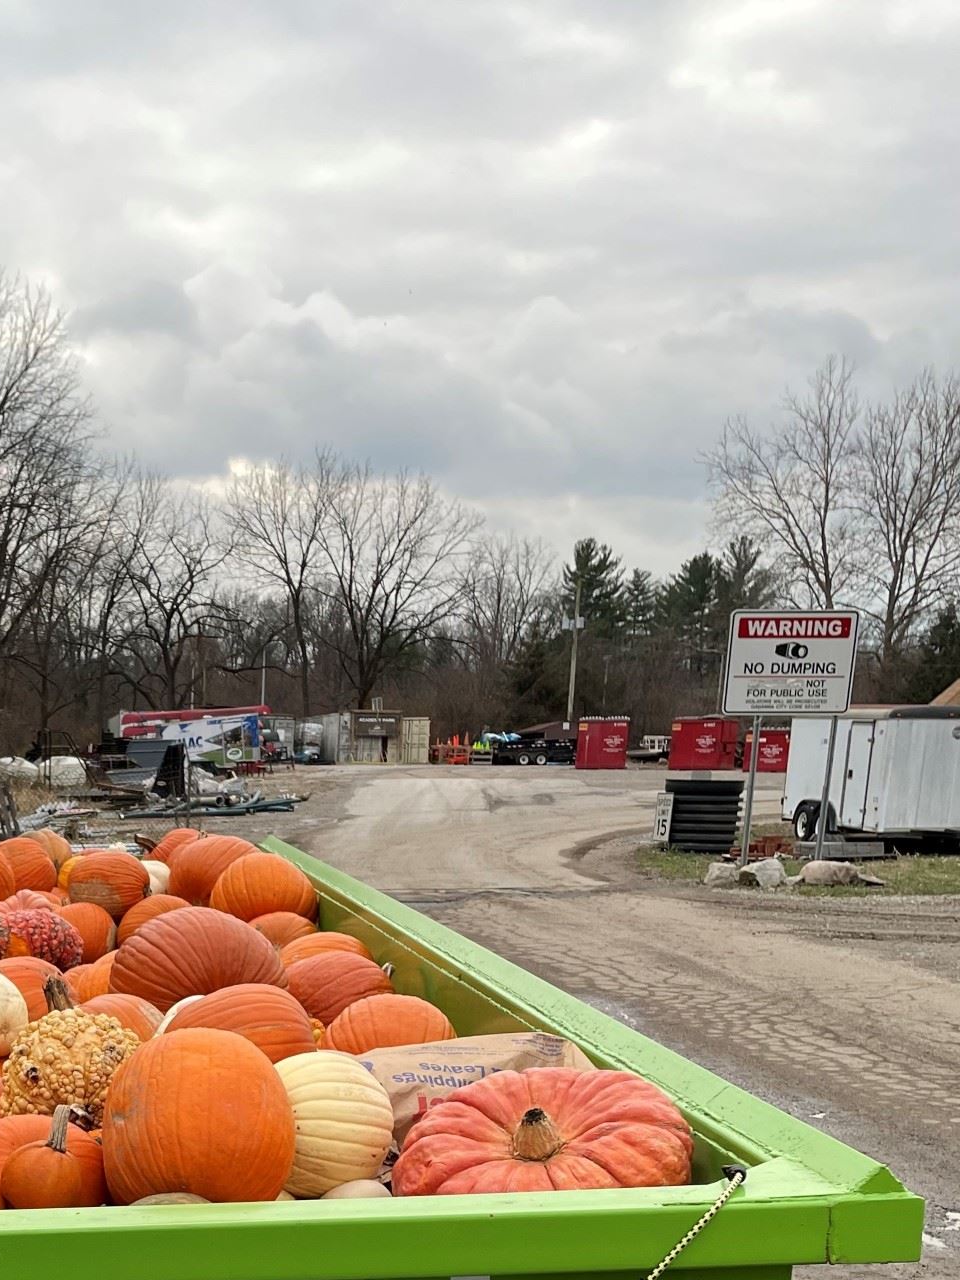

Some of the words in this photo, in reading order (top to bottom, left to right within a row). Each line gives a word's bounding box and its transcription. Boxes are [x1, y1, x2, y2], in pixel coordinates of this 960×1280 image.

[747, 620, 843, 637] WARNING
[743, 662, 765, 675] NO
[771, 662, 836, 674] DUMPING
[806, 679, 826, 688] NOT
[746, 688, 766, 697] FOR
[770, 688, 804, 697] PUBLIC
[808, 688, 828, 697] USE
[656, 818, 668, 836] 15
[418, 1062, 486, 1079] Leaves
[392, 1072, 475, 1089] lippings
